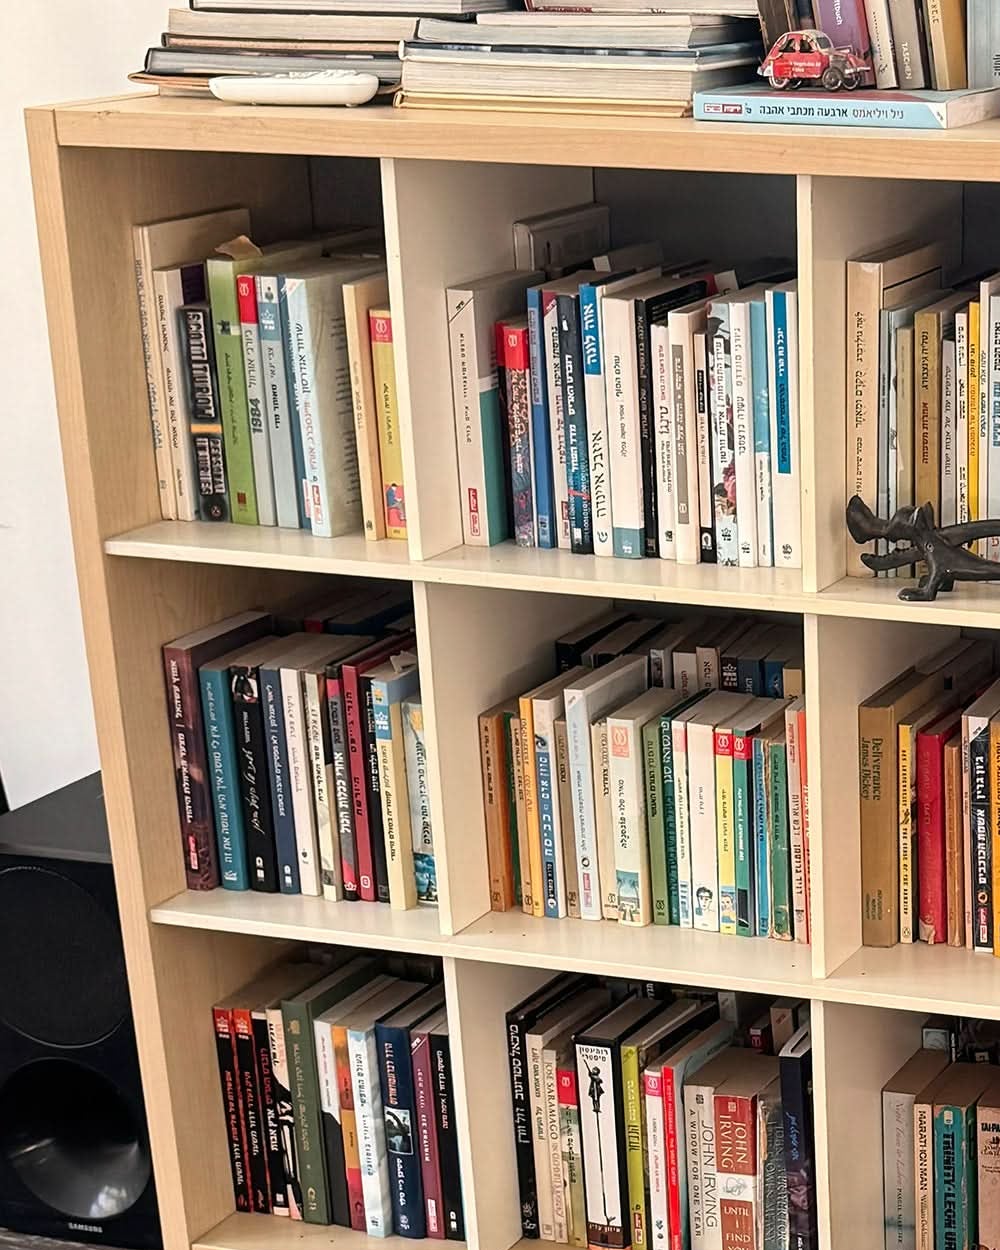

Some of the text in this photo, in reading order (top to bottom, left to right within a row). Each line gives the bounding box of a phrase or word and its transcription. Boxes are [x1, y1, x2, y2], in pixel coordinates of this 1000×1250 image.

[901, 42, 912, 80] TASCHEN
[760, 104, 904, 119] ניל ויליאמס ארבעה מכתבי אהבה
[186, 311, 214, 419] SCOTT TUROW
[612, 355, 624, 398] עולם הסוף
[249, 398, 263, 434] 1984
[583, 303, 607, 517] אוה לונה איזבל איינדה
[211, 438, 226, 493] PERSONAL
[209, 725, 220, 737] אין
[210, 740, 220, 748] לי
[215, 774, 225, 788] איך
[860, 737, 872, 801] James Dickey
[871, 738, 884, 801] Deliverance
[216, 792, 226, 809] היא
[219, 813, 230, 834] עושה
[222, 838, 231, 851] את
[223, 853, 233, 863] זה
[793, 844, 801, 875] גרוסמן
[795, 877, 803, 895] דויד
[269, 1129, 279, 1151] אבות
[719, 1114, 736, 1169] IRVING
[734, 1122, 749, 1163] JOHN
[689, 1109, 702, 1237] A WIDOW FOR ONE YEAR
[701, 1120, 717, 1228] JOHN IRVING
[723, 1206, 750, 1217] UNTIL
[68, 1222, 103, 1233] SAMSUNG
[725, 1233, 751, 1243] FIND
